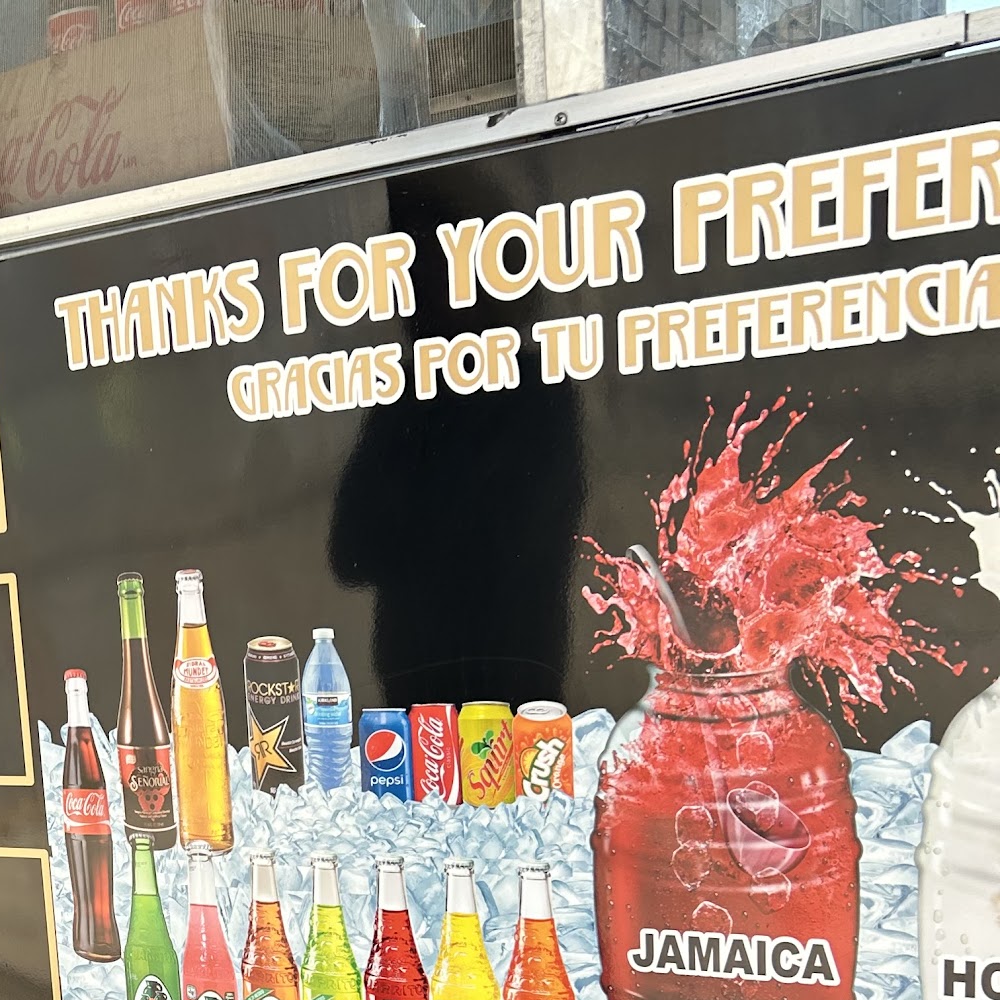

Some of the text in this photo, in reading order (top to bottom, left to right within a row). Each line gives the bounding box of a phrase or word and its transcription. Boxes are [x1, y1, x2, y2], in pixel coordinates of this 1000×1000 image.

[56, 121, 1000, 371] THANKS FOR YOUR PREFER
[226, 254, 1000, 422] GRACIAS POR TU PREFERENCIA
[370, 774, 405, 787] pepsi
[467, 719, 513, 800] Squirt
[522, 737, 566, 802] Crush
[627, 928, 841, 986] JAMAICA
